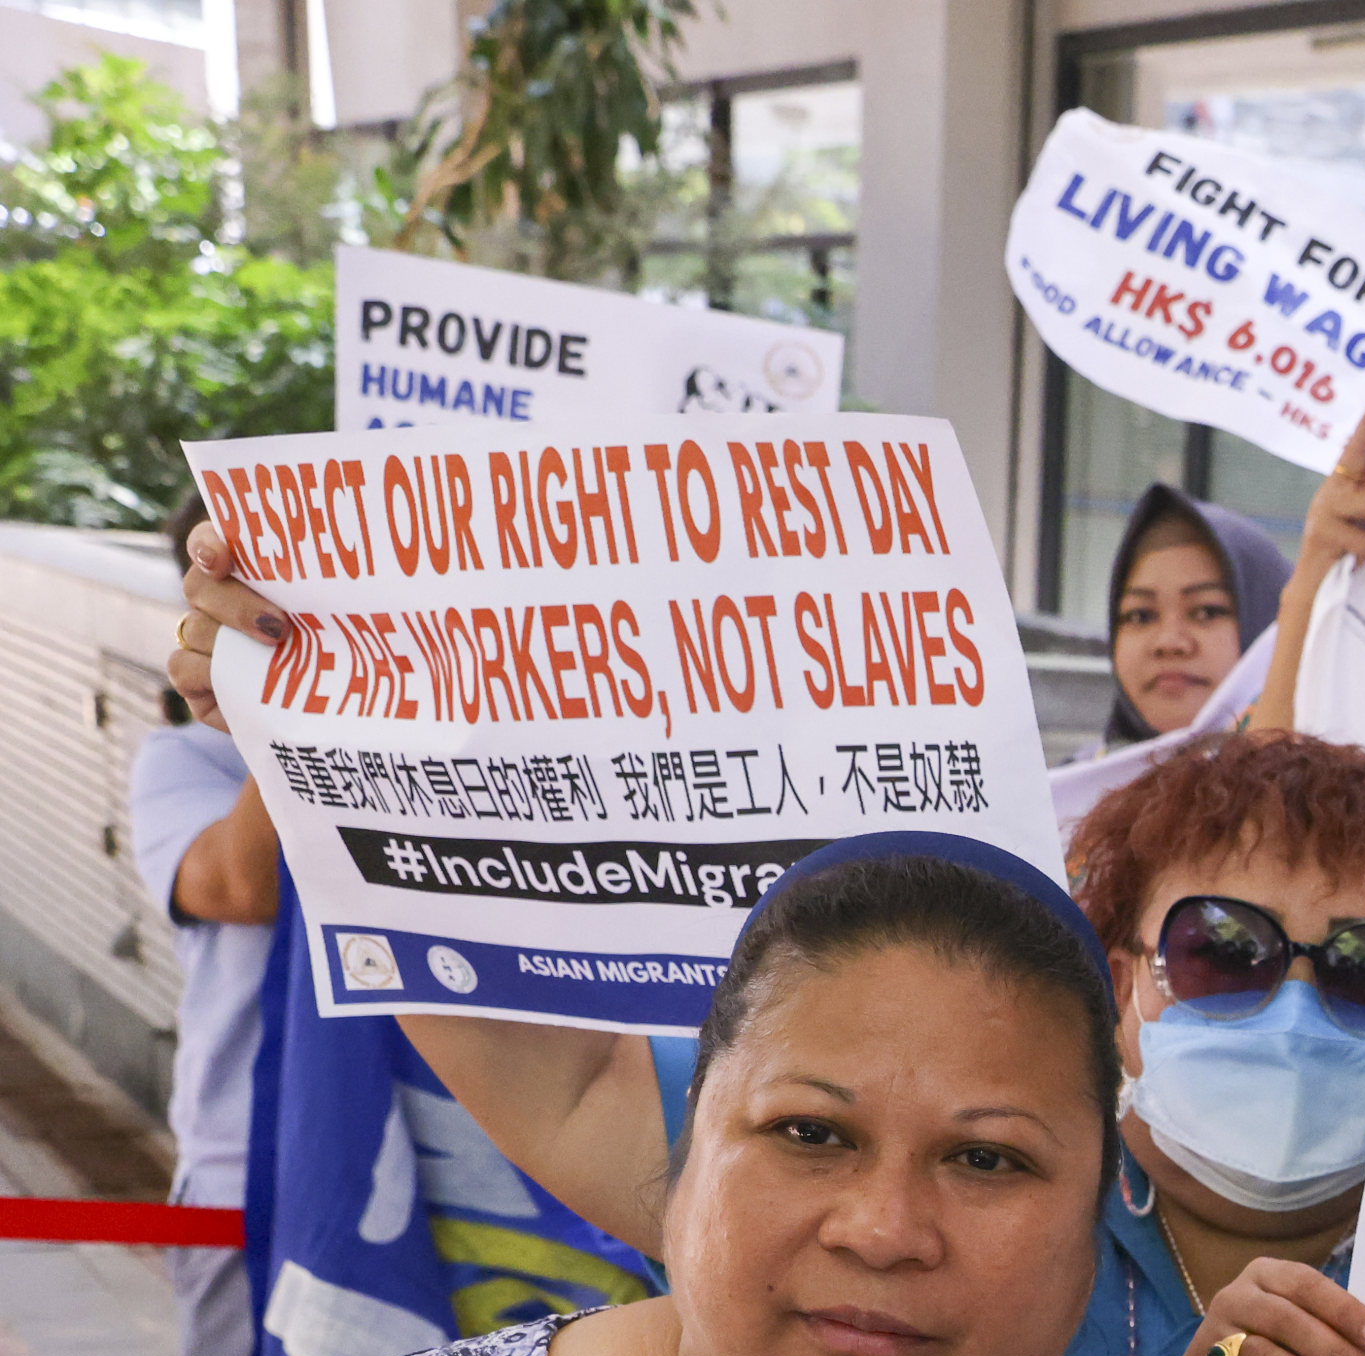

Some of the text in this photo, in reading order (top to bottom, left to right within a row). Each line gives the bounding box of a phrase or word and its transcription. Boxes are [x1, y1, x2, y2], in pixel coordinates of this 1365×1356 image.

[1057, 173, 1246, 284] LIVING
[1145, 150, 1286, 243] FIGHT
[361, 299, 589, 378] PROVIDE
[1111, 271, 1212, 341] HK$
[361, 362, 533, 422] HUMANE
[1083, 317, 1251, 391] ALLOWANCE
[201, 439, 953, 584] RESPECT OUR RIGHT TO REST DAY
[260, 588, 987, 739] WE ARE WORKERS, NOT SLAVES
[270, 739, 604, 825] 尊重我們休息日的權利
[383, 837, 793, 911] #IncludeMigra
[518, 952, 596, 984] ASIAN
